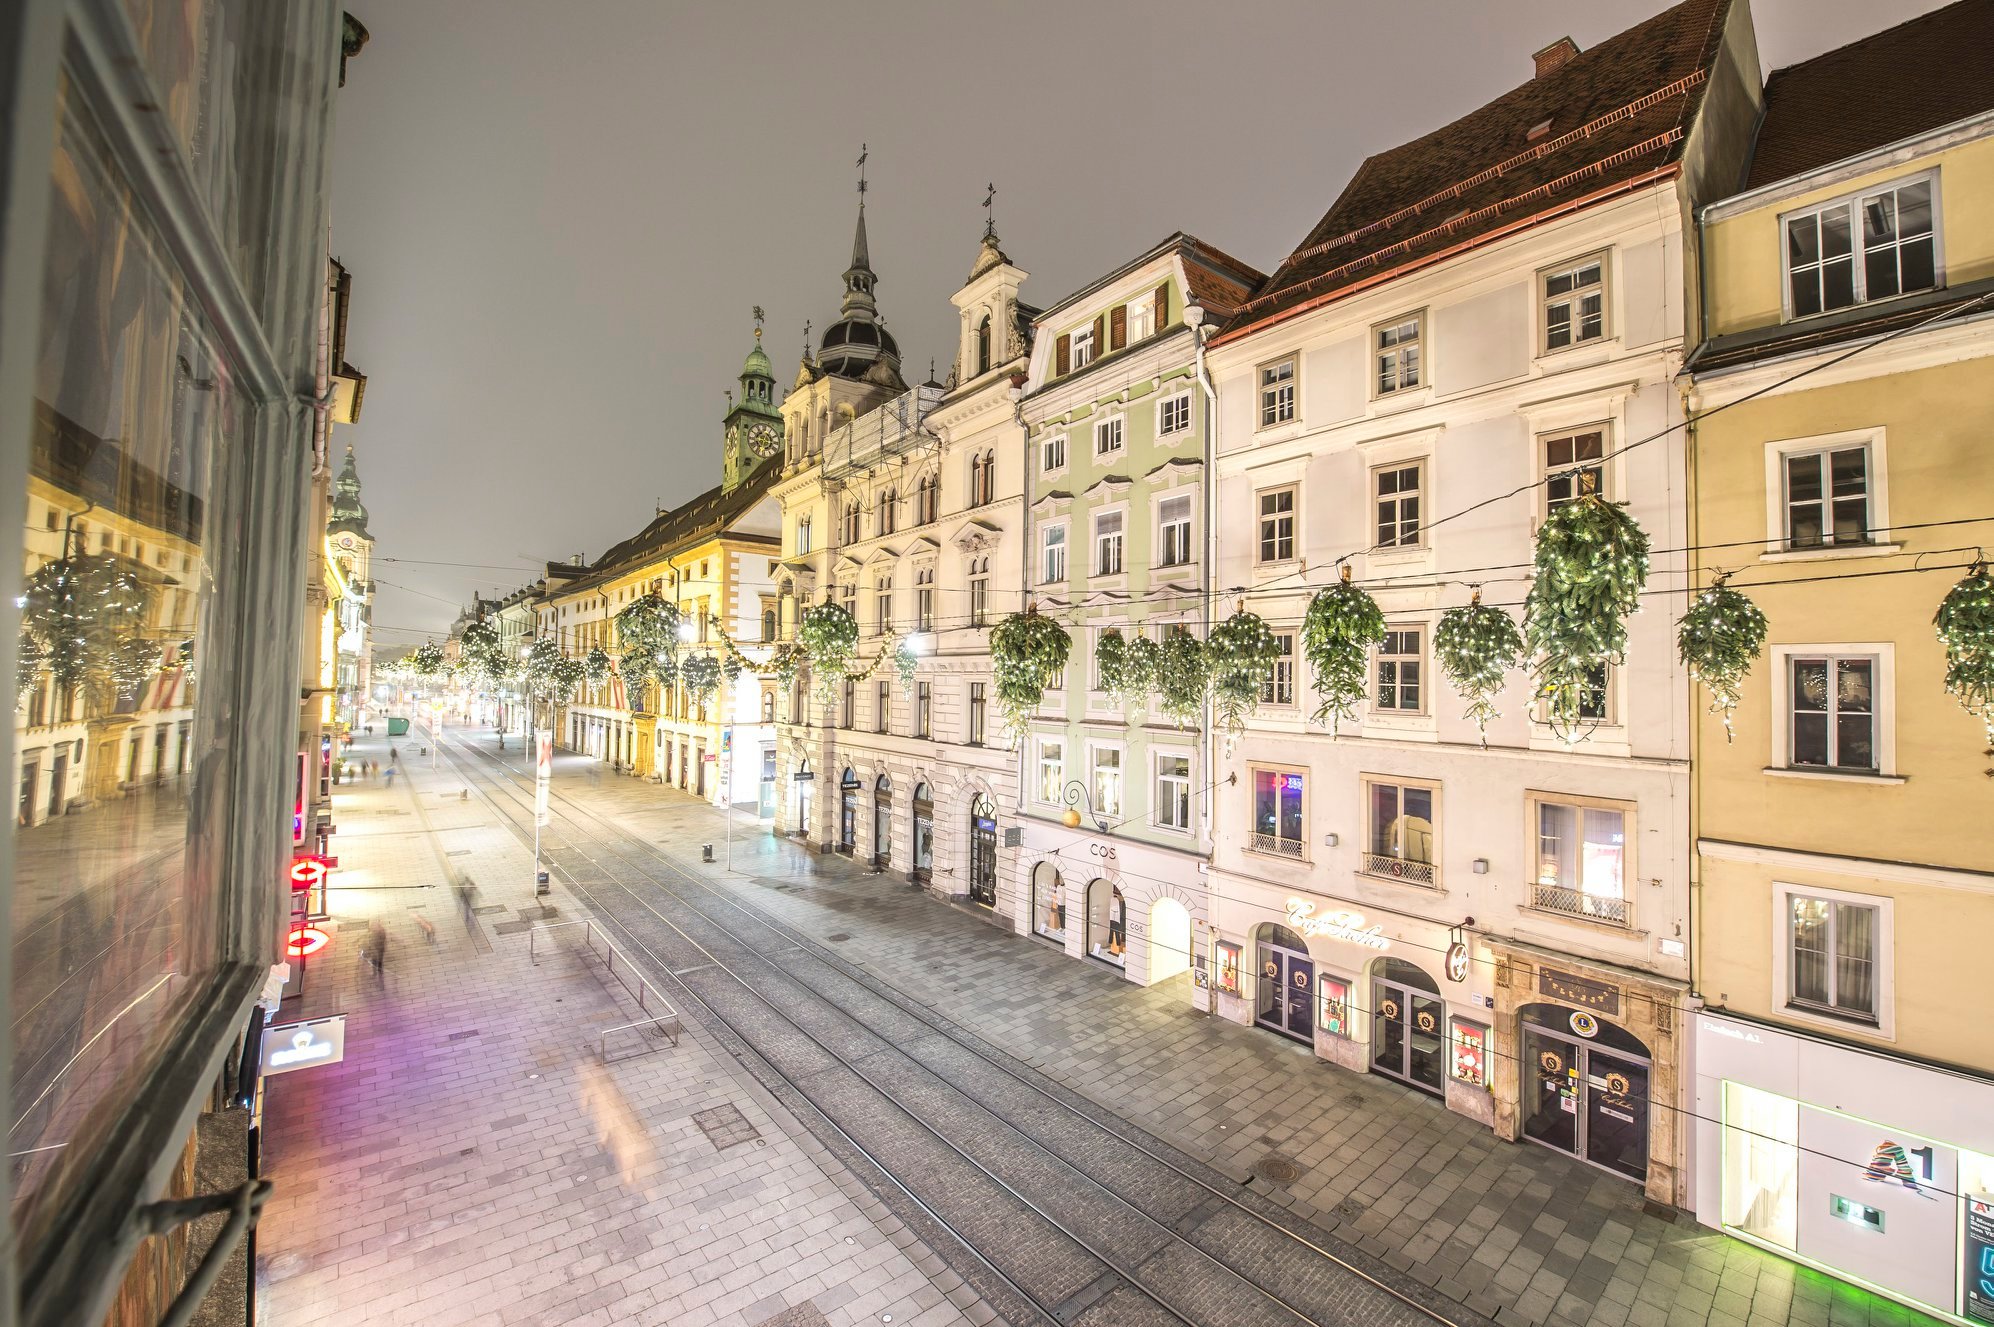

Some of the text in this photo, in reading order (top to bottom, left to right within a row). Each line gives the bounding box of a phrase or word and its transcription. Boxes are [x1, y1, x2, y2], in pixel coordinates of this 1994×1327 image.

[1090, 843, 1117, 860] COS
[1129, 922, 1144, 933] COS
[1862, 1140, 1933, 1189] A1
